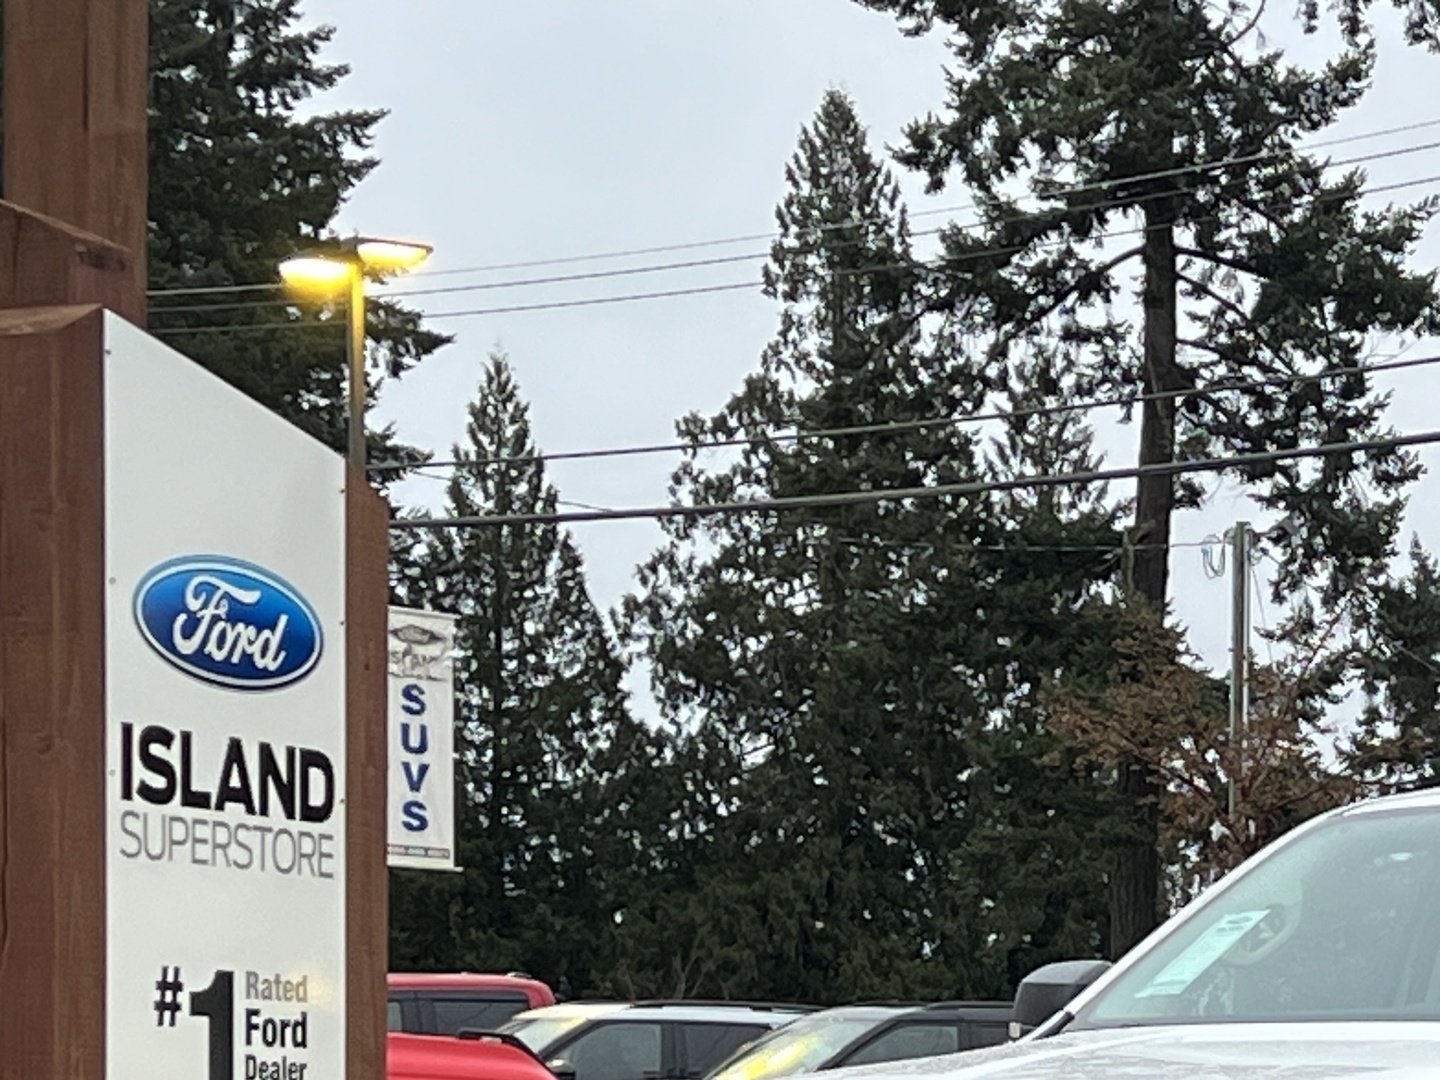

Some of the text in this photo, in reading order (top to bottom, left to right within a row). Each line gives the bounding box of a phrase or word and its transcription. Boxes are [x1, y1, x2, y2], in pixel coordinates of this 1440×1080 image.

[172, 575, 289, 671] Ford
[121, 722, 335, 823] ISLAND
[400, 684, 430, 832] SUVS
[120, 810, 334, 879] SUPERSTORE
[245, 970, 308, 1003] Rated
[245, 1008, 308, 1049] Ford
